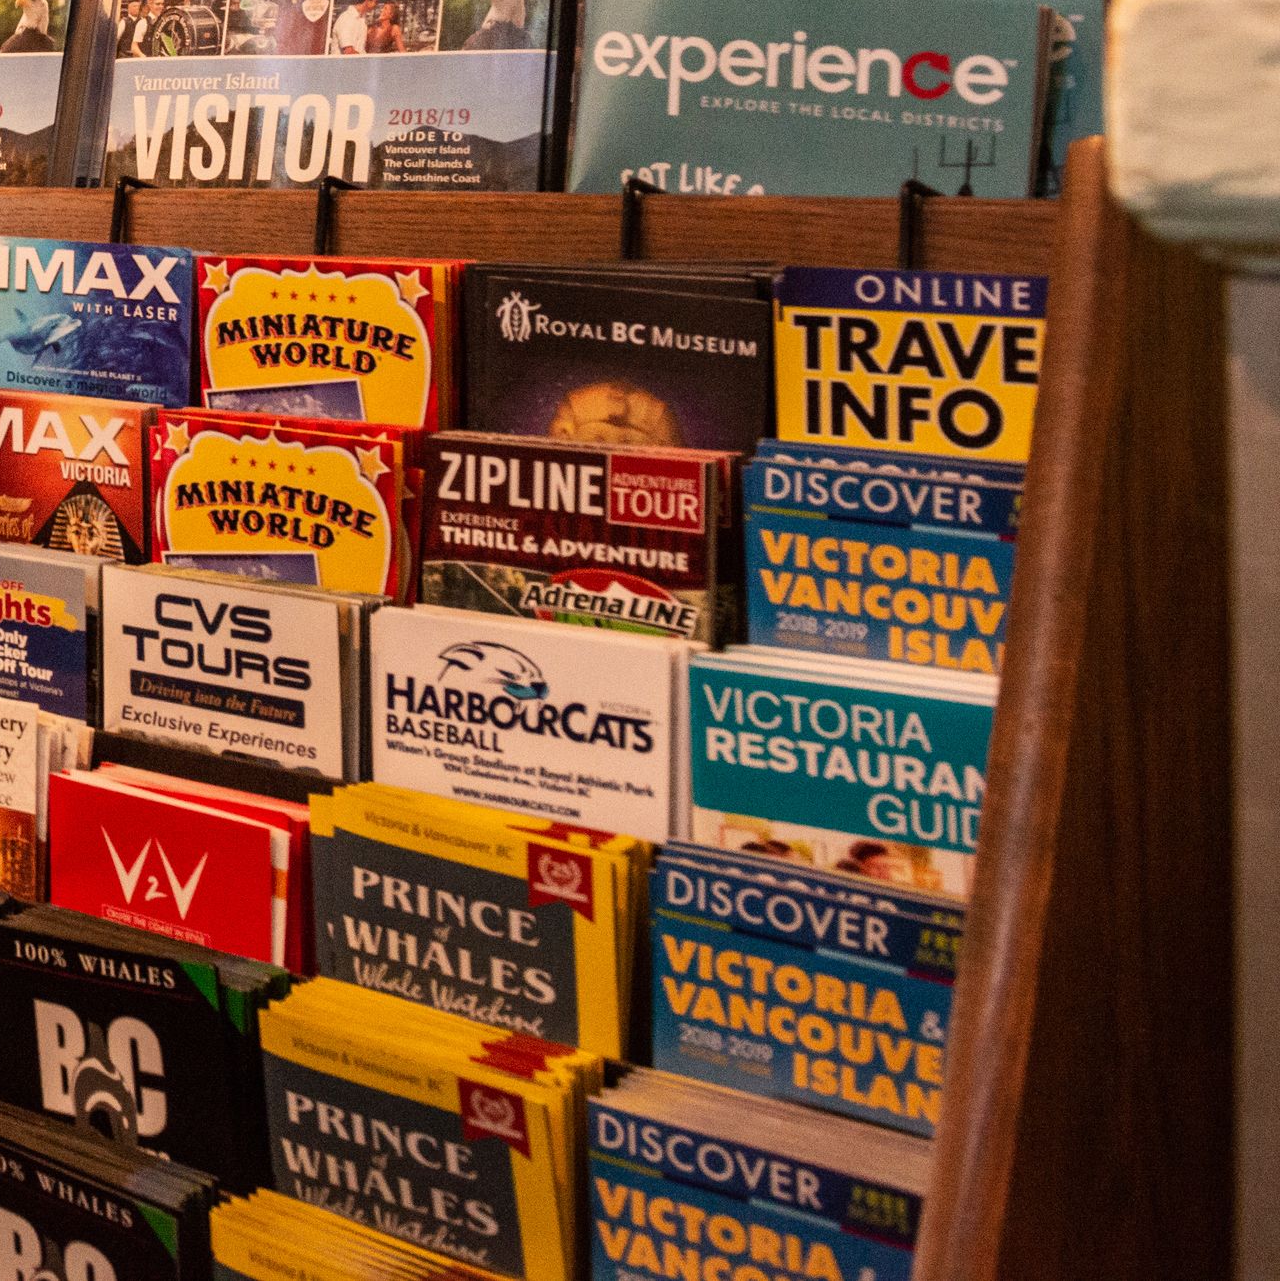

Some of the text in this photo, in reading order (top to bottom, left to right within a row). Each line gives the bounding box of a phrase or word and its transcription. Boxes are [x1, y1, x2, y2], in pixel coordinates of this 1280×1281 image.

[593, 30, 1009, 117] experience
[700, 95, 1006, 133] EXPLORE THE LOCAL DISTRICTS
[73, 301, 179, 322] WITH LASER
[855, 275, 1032, 310] ONLINE
[216, 313, 418, 361] MINIATURE
[612, 322, 646, 347] BC
[252, 342, 377, 376] WORLD
[805, 379, 1005, 450] INFO
[438, 452, 604, 517] ZIPLINE
[611, 471, 697, 494] ADVENTURE
[611, 484, 699, 523] TOUR
[155, 594, 273, 642] CVS
[122, 625, 312, 691] TOURS
[386, 714, 504, 754] BASEBALL
[702, 684, 933, 753] VICTORIA
